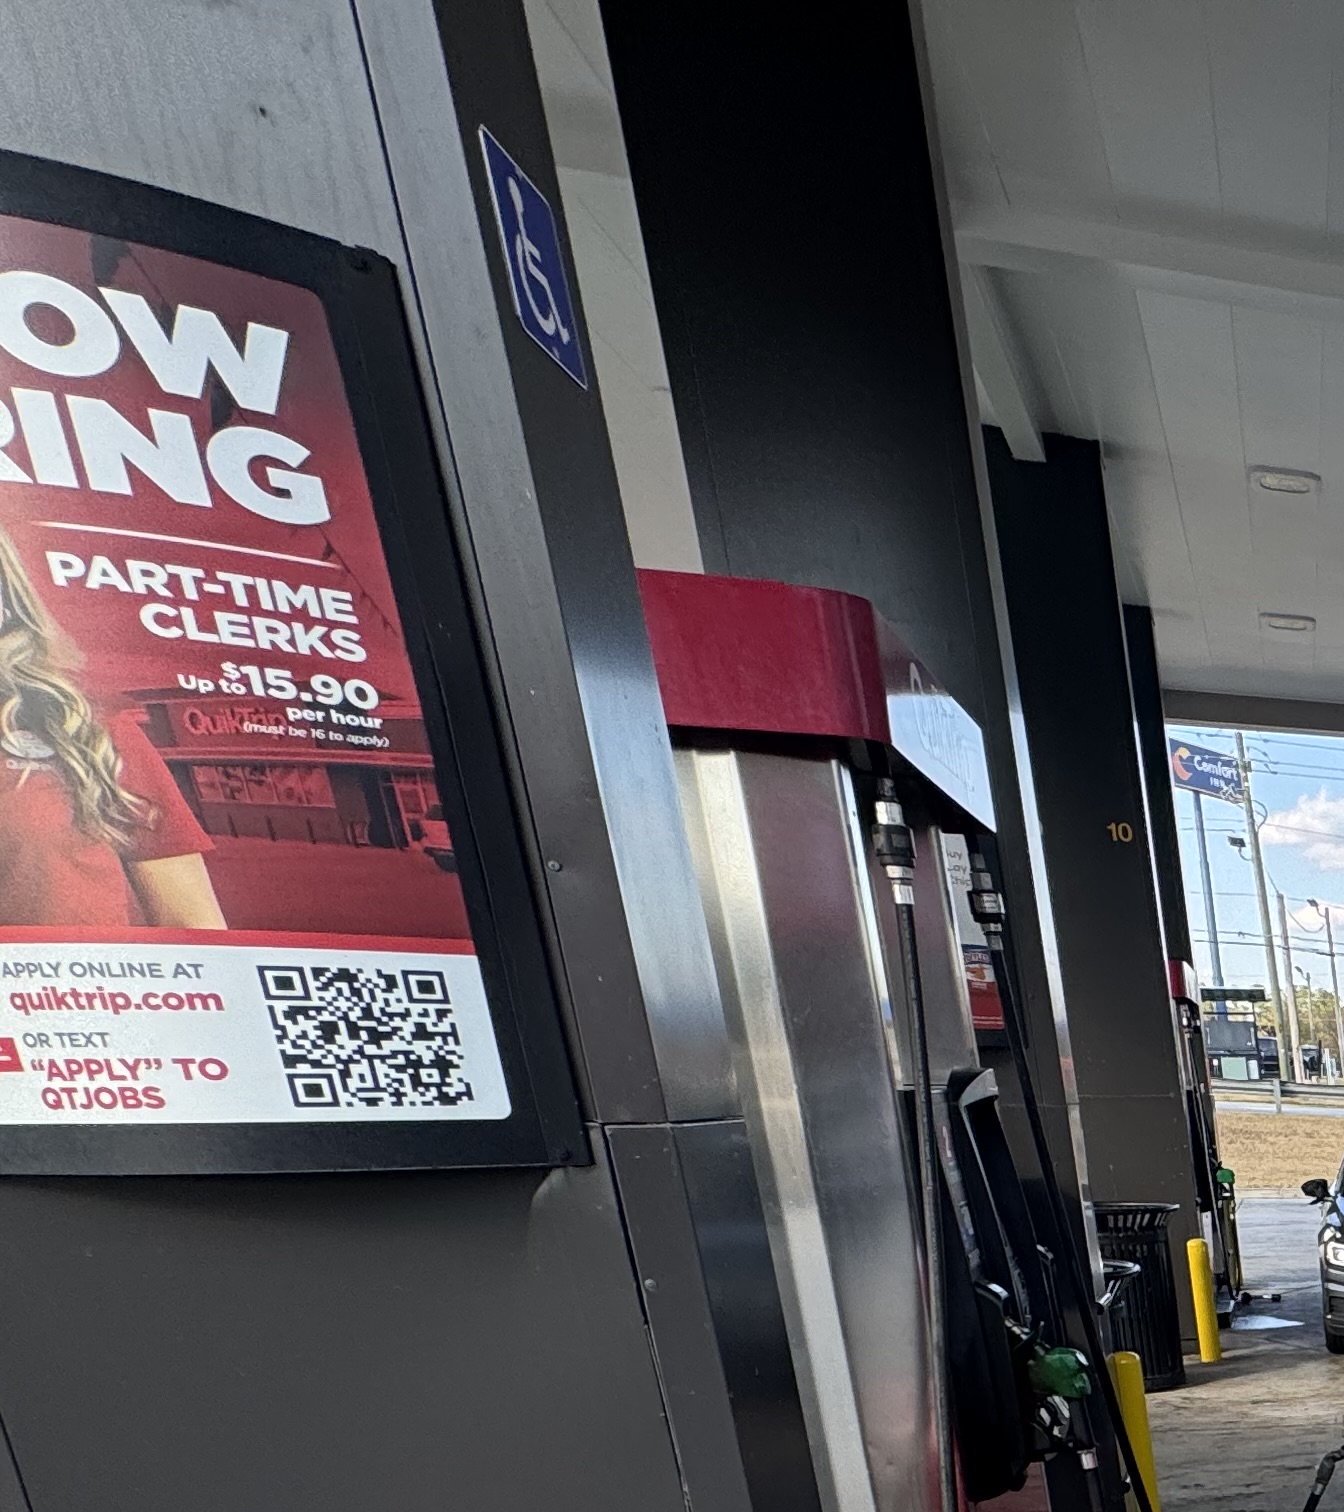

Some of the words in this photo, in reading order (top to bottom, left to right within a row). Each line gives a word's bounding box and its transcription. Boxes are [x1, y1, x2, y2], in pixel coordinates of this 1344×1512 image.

[45, 550, 359, 624] PART-TIME
[139, 603, 368, 662] CLERKS
[177, 673, 215, 694] Up
[218, 678, 247, 695] to
[220, 661, 379, 710] $15.90
[286, 706, 325, 723] per
[330, 708, 383, 730] hour
[243, 721, 285, 736] (must
[288, 725, 307, 738] be
[311, 728, 326, 740] 16
[329, 730, 344, 741] to
[346, 734, 390, 748] apply)
[1193, 755, 1239, 781] Comfort
[1106, 821, 1133, 843] 10
[2, 961, 62, 979] APPLY
[68, 961, 165, 979] ONLINE
[172, 962, 204, 979] AT
[9, 985, 225, 1016] quiktrip.com
[22, 1032, 53, 1048] OR
[54, 1032, 109, 1048] TEXT
[171, 1057, 229, 1081] TO
[41, 1086, 166, 1110] QTJOBS
